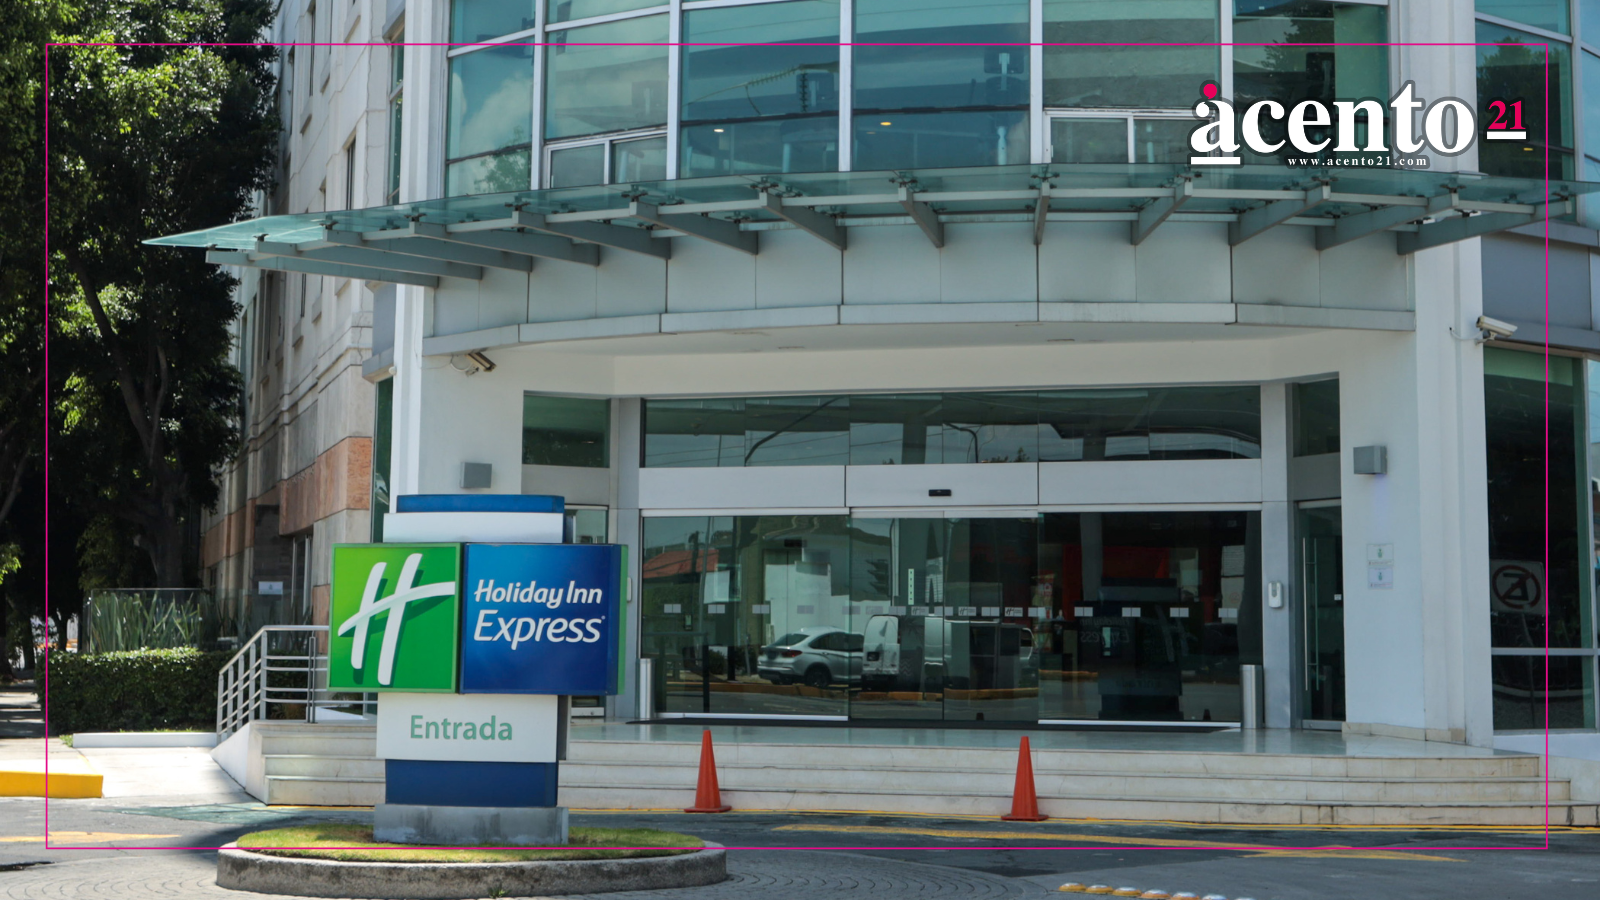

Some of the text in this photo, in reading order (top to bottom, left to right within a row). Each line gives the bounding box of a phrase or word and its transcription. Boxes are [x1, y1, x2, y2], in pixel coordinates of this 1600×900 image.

[474, 579, 603, 609] Holiday Inn
[474, 609, 602, 651] Express
[410, 714, 513, 742] Entrada
